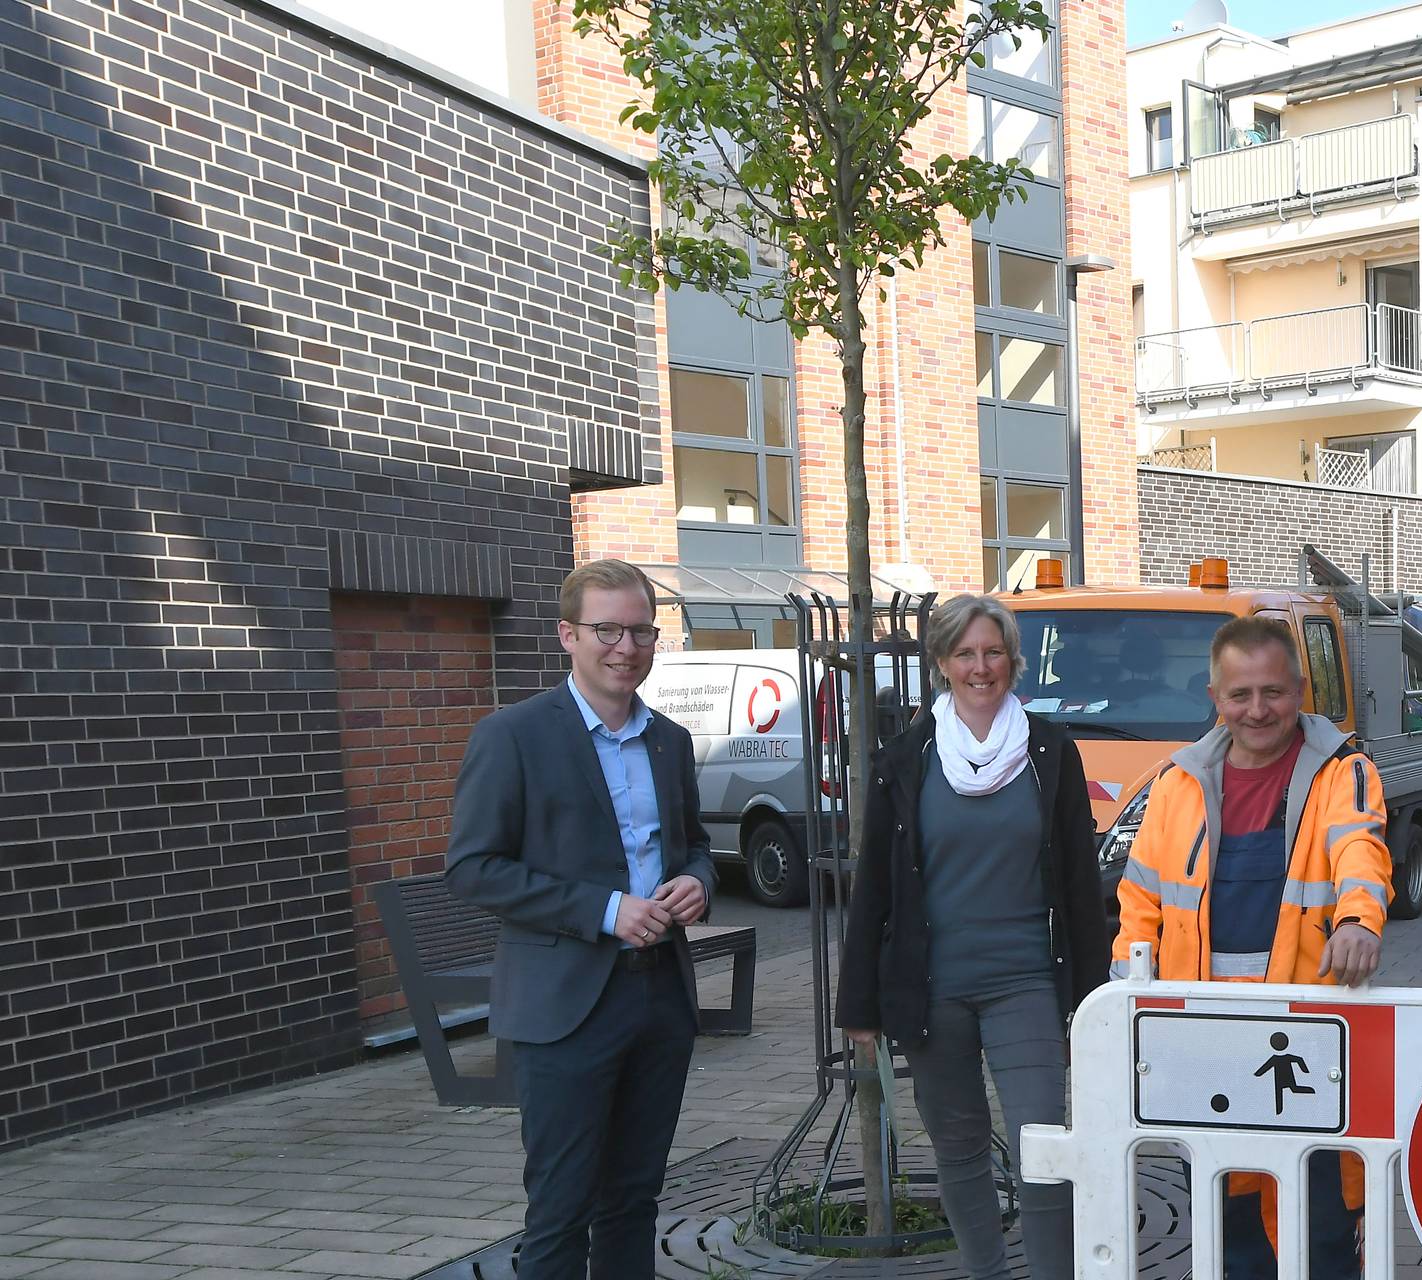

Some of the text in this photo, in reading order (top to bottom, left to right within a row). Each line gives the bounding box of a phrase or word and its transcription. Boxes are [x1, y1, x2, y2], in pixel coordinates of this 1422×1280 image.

[657, 684, 730, 699] Sanierung von Wasser-
[668, 701, 714, 714] Brandschäden
[728, 740, 789, 758] WABRATEC
